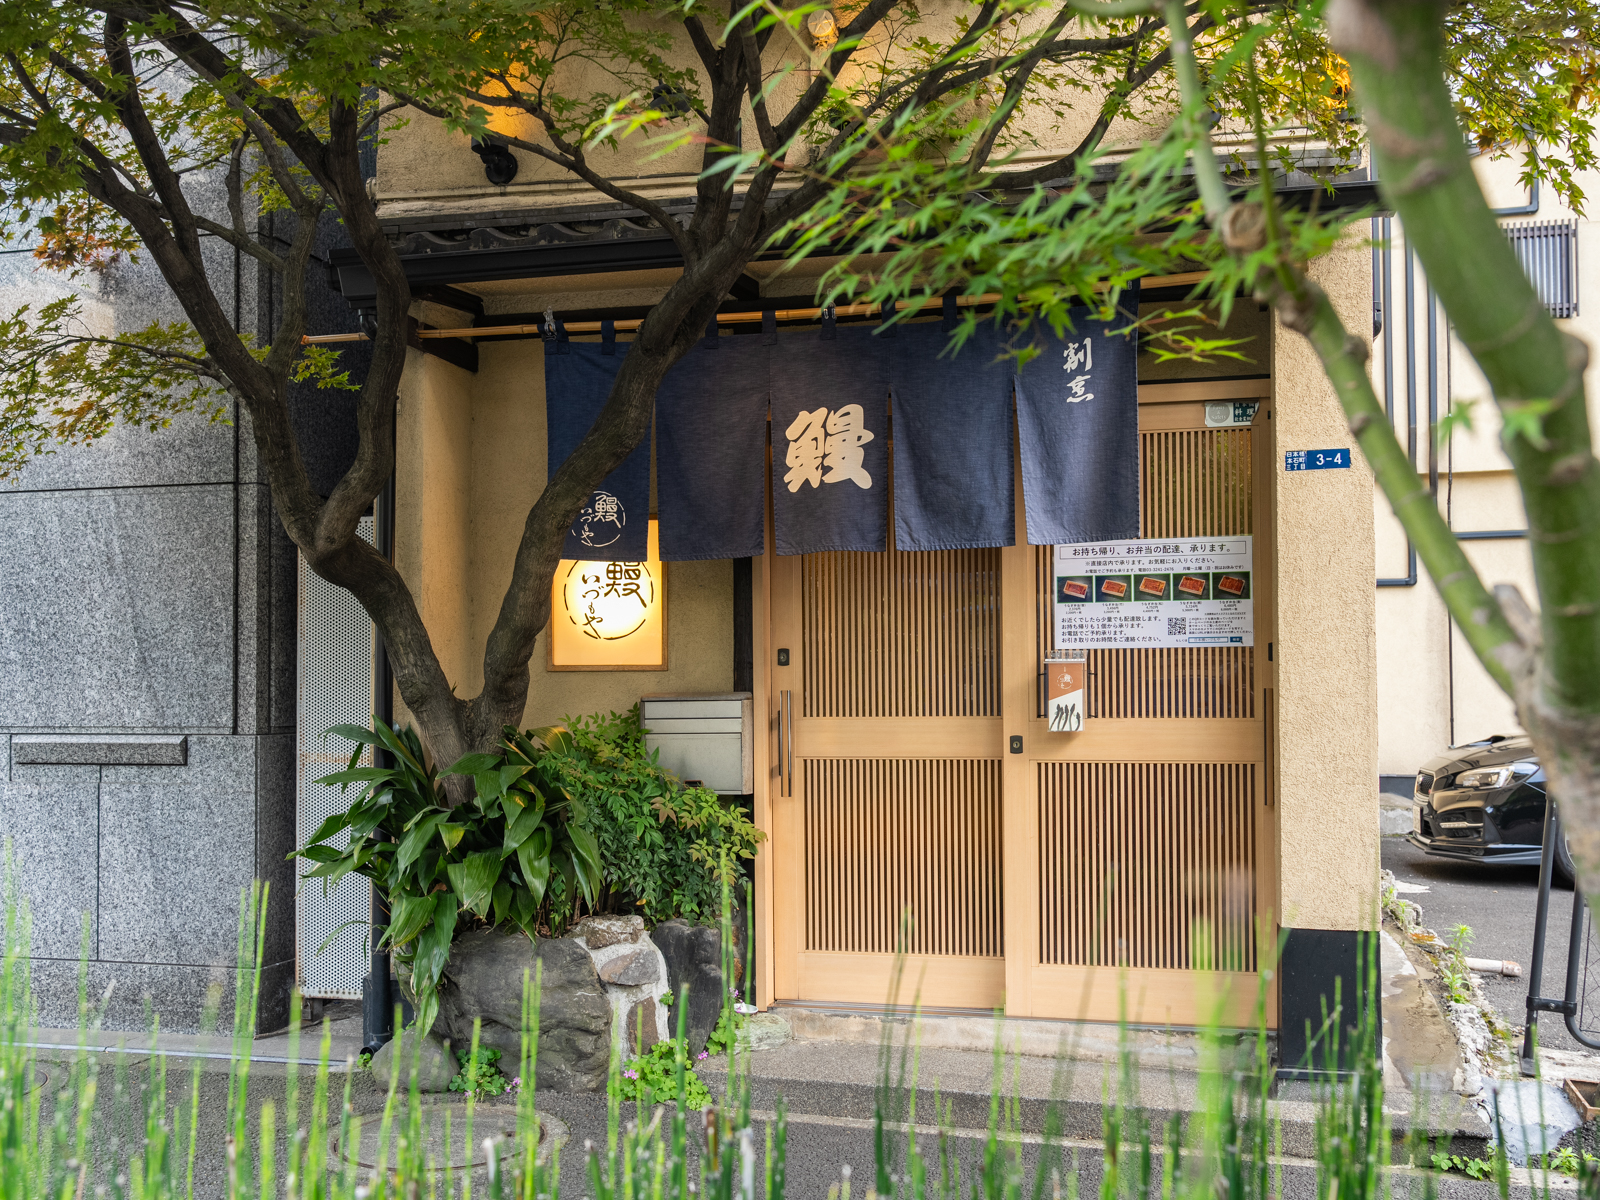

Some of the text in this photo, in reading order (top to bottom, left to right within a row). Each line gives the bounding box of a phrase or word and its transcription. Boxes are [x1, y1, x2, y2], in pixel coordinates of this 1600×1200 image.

[1063, 337, 1094, 403] 割烹
[783, 403, 875, 493] 鰻
[1316, 452, 1342, 466] 3-4
[1072, 543, 1231, 556] お持ち帰り、お弁当の配達、承ります。
